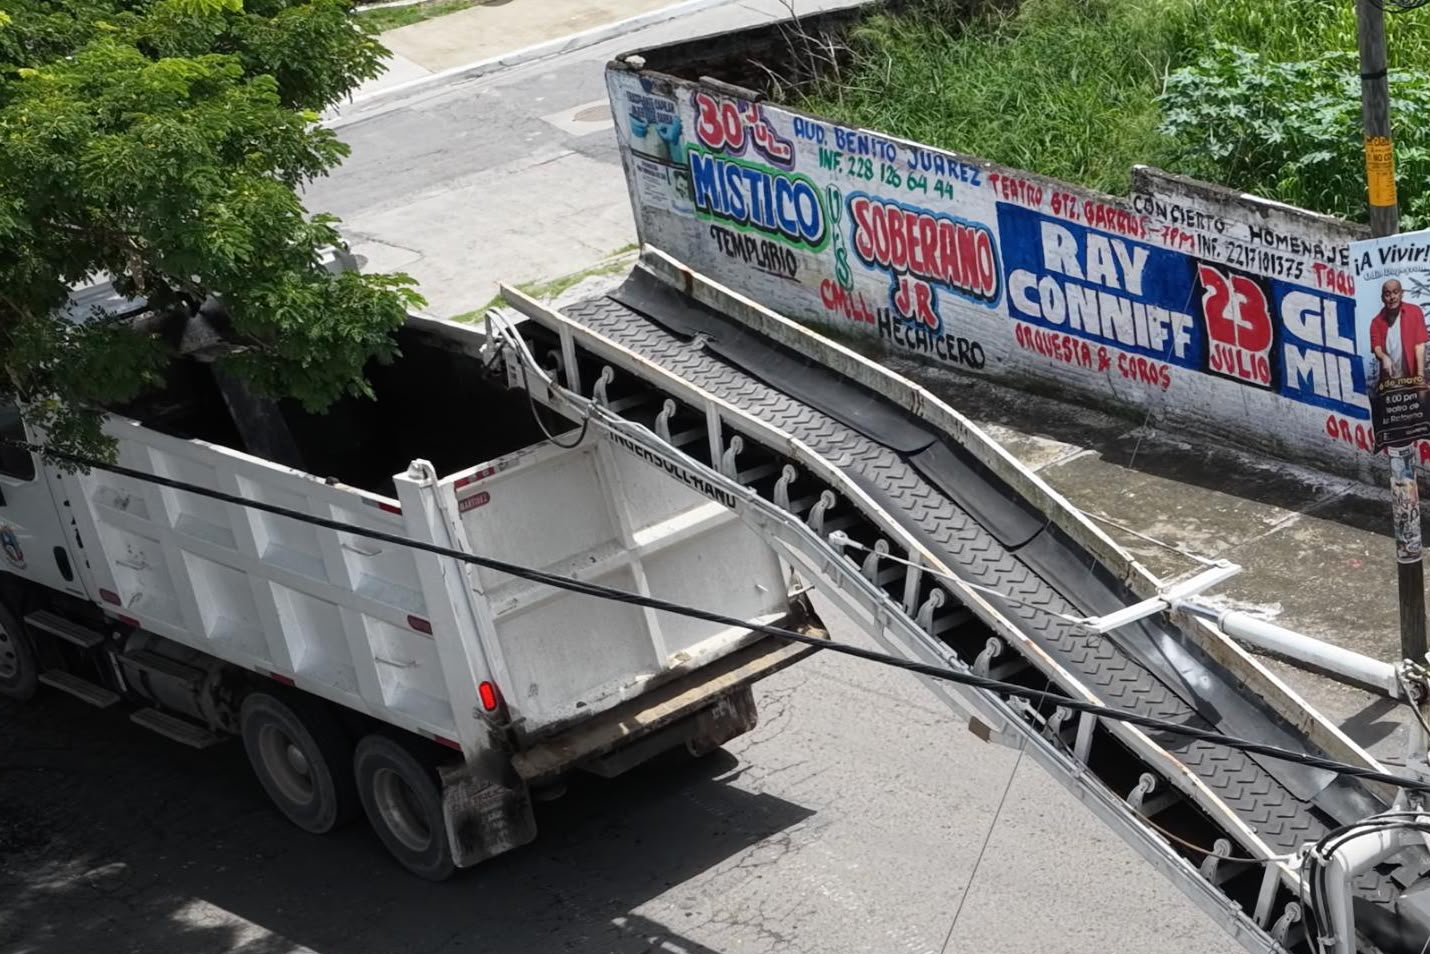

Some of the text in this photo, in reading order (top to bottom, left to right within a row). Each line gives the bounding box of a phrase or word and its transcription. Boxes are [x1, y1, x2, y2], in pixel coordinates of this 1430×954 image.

[696, 92, 746, 149] 30
[793, 117, 982, 187] AUD. BENITO JUAREZ
[819, 147, 954, 200] INF. 228 126 64 44
[688, 150, 824, 242] MISTICO
[988, 172, 1043, 206] TEATRO
[711, 225, 797, 277] TEMPLARIO
[853, 198, 996, 295] SOBERANO
[1040, 220, 1150, 297] RAY
[1133, 196, 1350, 266] CONCIERTO HOMENAJE
[1198, 234, 1220, 257] INF.
[1354, 251, 1372, 276] ¡A
[1378, 243, 1430, 265] Vivir!
[895, 278, 938, 329] JR
[1199, 263, 1272, 352] 23
[1312, 263, 1355, 297] TAQU
[877, 308, 986, 369] HECHICERO
[1008, 268, 1194, 359] CONNIFF
[1015, 322, 1171, 390] ORQUESTA & COROS
[1209, 344, 1272, 385] JULIO
